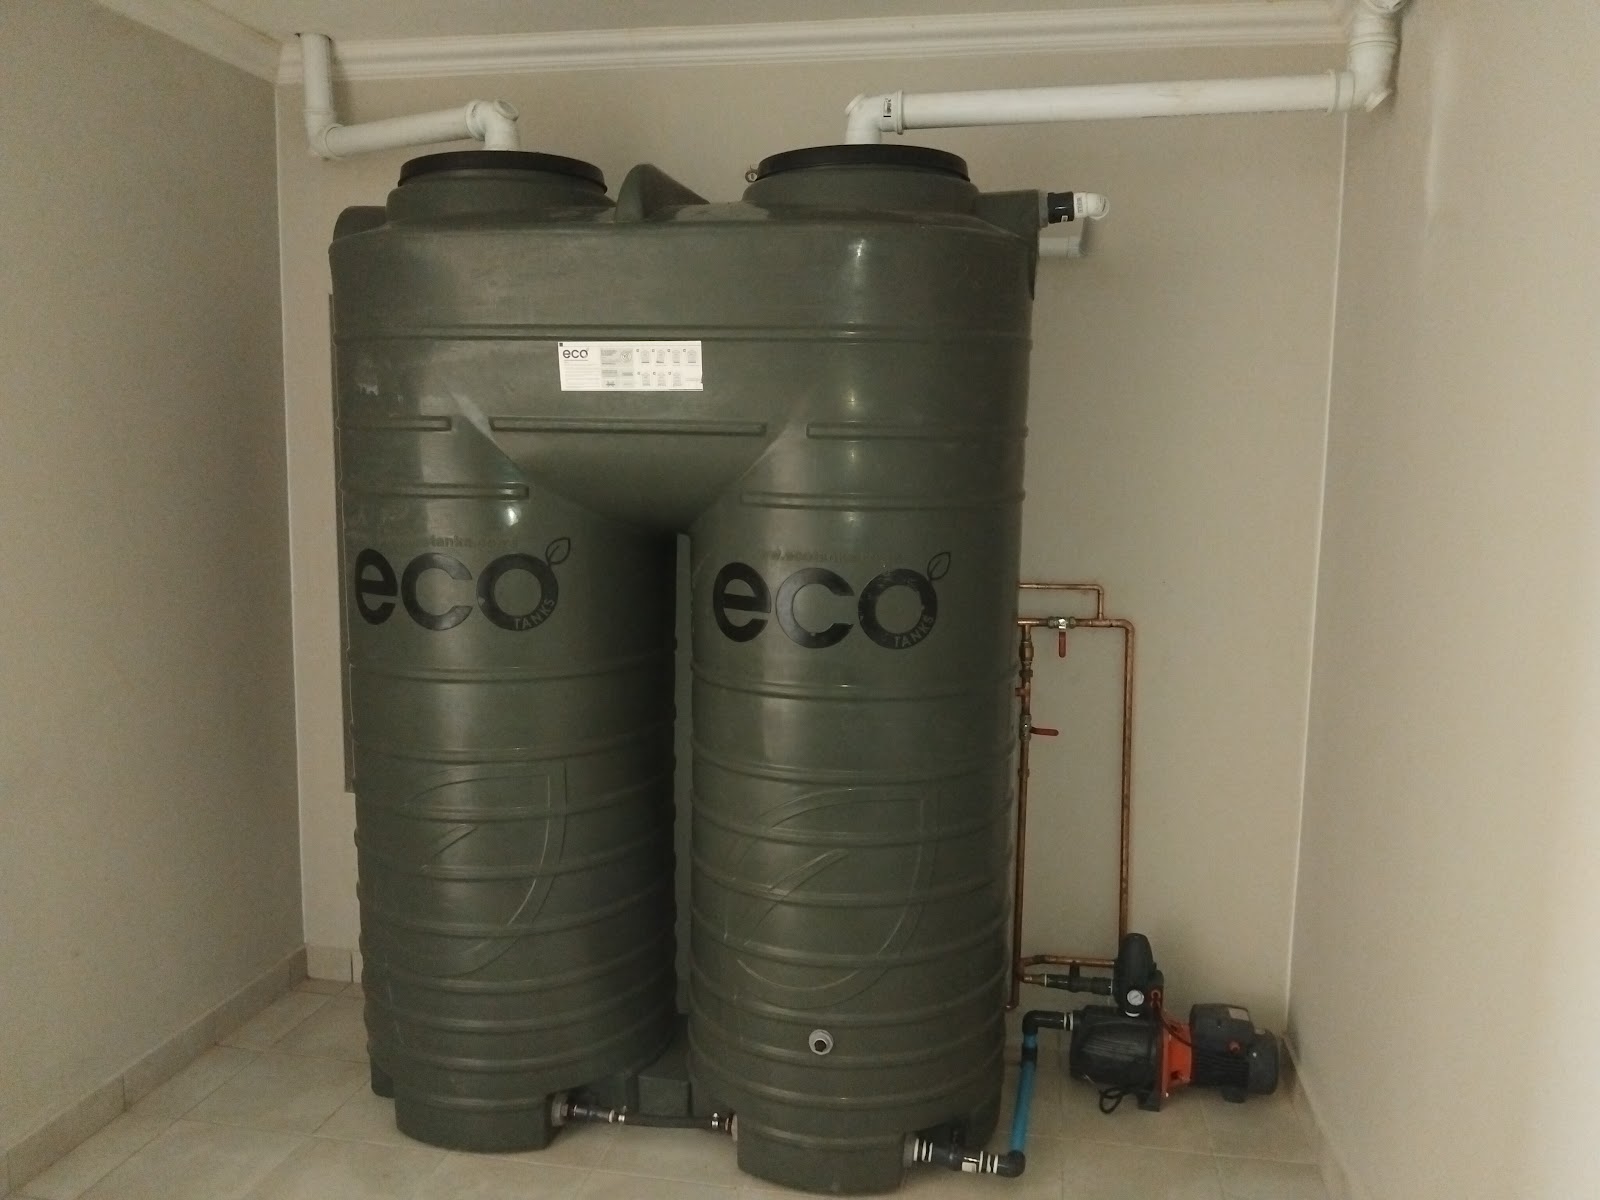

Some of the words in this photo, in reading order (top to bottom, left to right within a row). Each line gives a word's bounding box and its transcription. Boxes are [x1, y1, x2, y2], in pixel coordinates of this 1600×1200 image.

[562, 349, 588, 359] eco
[355, 548, 559, 631] eco
[713, 561, 938, 650] eco
[513, 599, 556, 630] TANKS
[893, 614, 935, 648] TANKS
